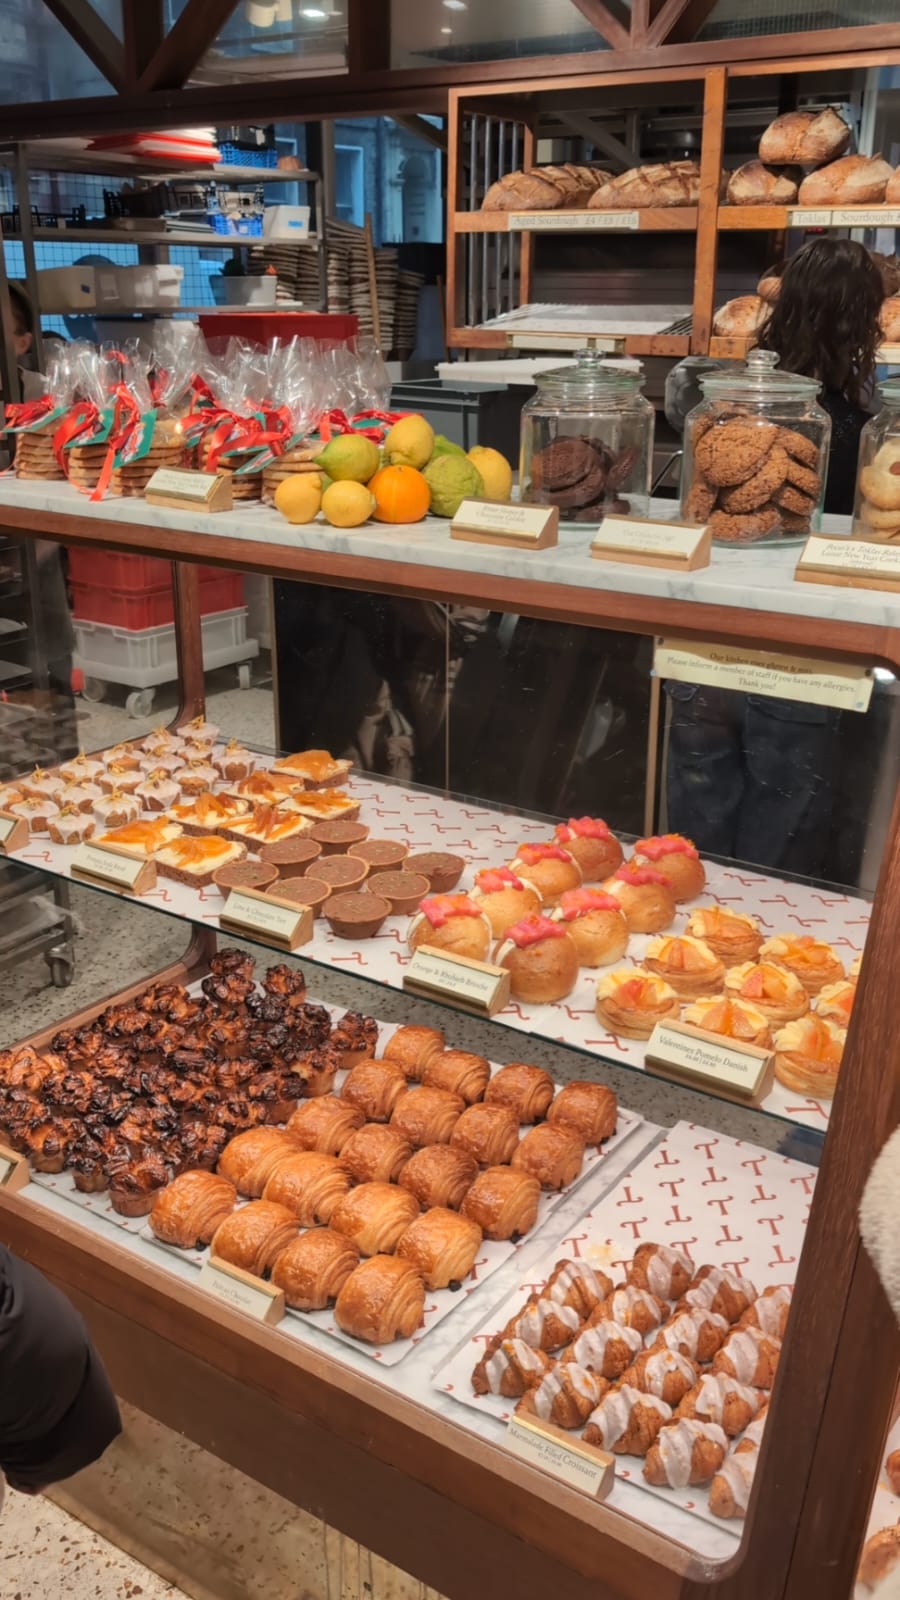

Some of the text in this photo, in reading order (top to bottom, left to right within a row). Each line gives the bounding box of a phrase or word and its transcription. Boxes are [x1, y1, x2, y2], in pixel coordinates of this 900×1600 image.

[841, 211, 894, 225] Sourdough
[709, 652, 725, 661] Our
[667, 656, 688, 667] Please
[689, 658, 713, 669] inform
[719, 664, 746, 675] member
[747, 667, 755, 676] of
[755, 669, 771, 679] staff
[779, 674, 794, 684] you
[794, 675, 809, 686] have
[809, 679, 822, 689] any
[822, 680, 857, 693] allergies.
[738, 678, 777, 690] Thank you!
[412, 962, 433, 974] Orange
[440, 969, 465, 983] Rhubarb
[465, 978, 489, 991] Brioche
[659, 1035, 694, 1053] Valentines
[695, 1047, 721, 1063] Pomelo
[722, 1056, 749, 1072] Danish
[509, 1427, 544, 1450] Marmalade
[543, 1445, 562, 1459] Filled
[562, 1453, 598, 1479] Croissant
